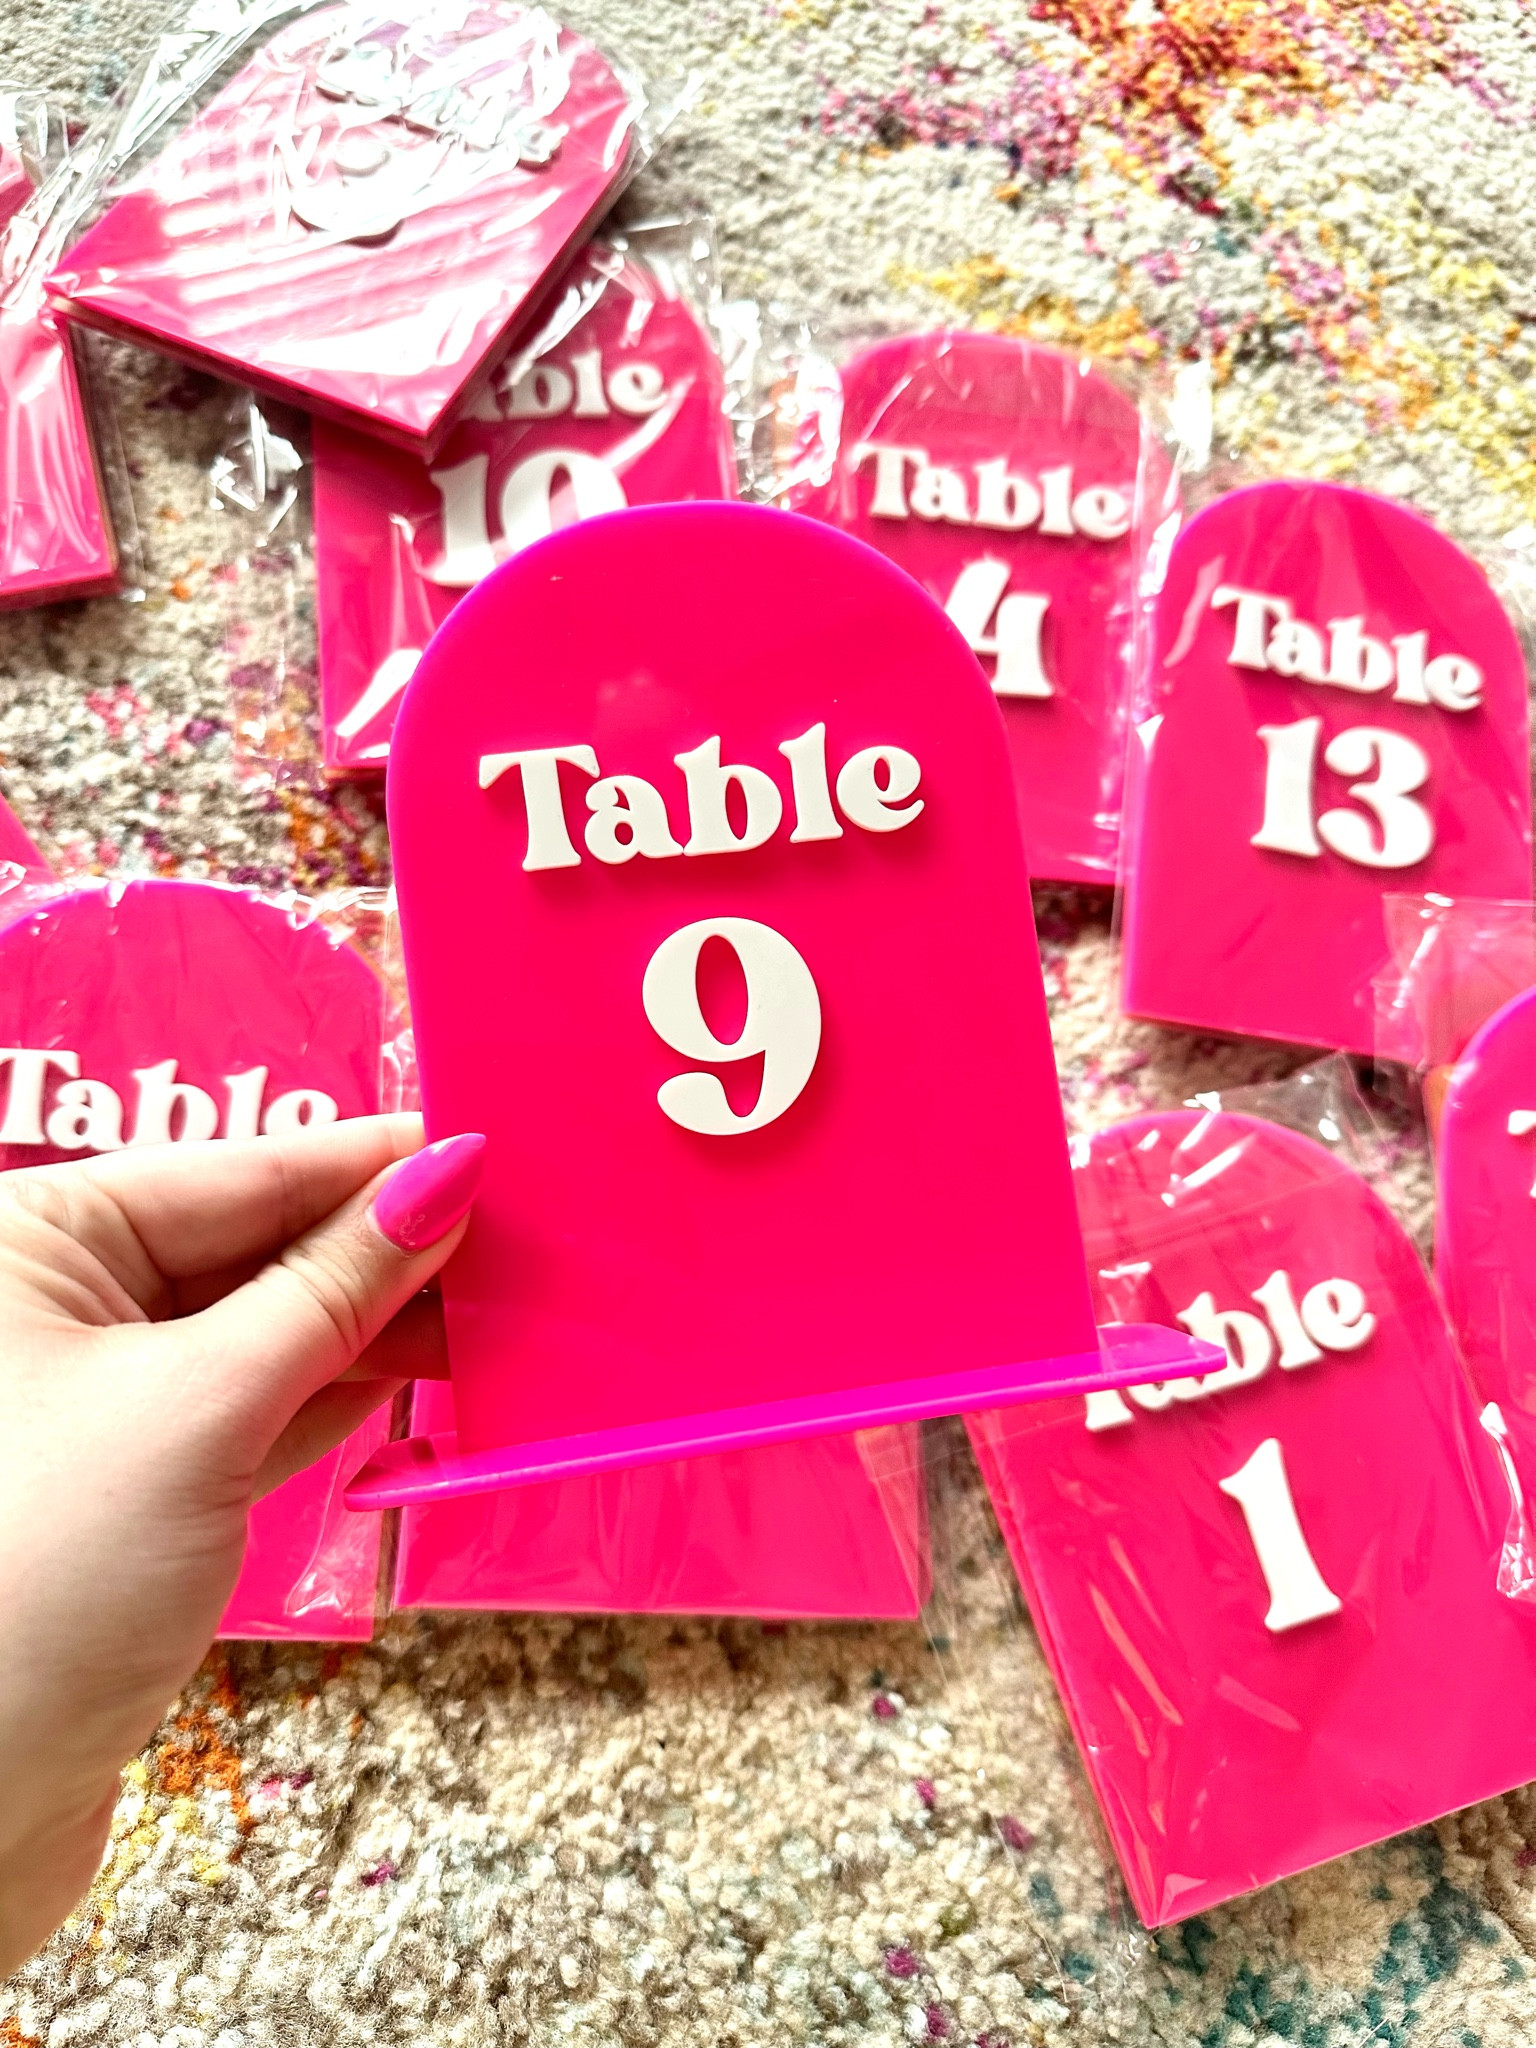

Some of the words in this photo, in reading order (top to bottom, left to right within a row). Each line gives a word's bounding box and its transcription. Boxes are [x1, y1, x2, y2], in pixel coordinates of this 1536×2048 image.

[459, 349, 670, 422] ble
[422, 450, 627, 587] 10
[854, 442, 1131, 541] Table
[946, 557, 1056, 699] 4
[1211, 586, 1484, 713] Table
[478, 722, 926, 871] Table
[1250, 717, 1435, 869] 13
[642, 917, 822, 1136] 9
[1084, 1269, 1377, 1433] ble
[1219, 1437, 1343, 1632] 1
